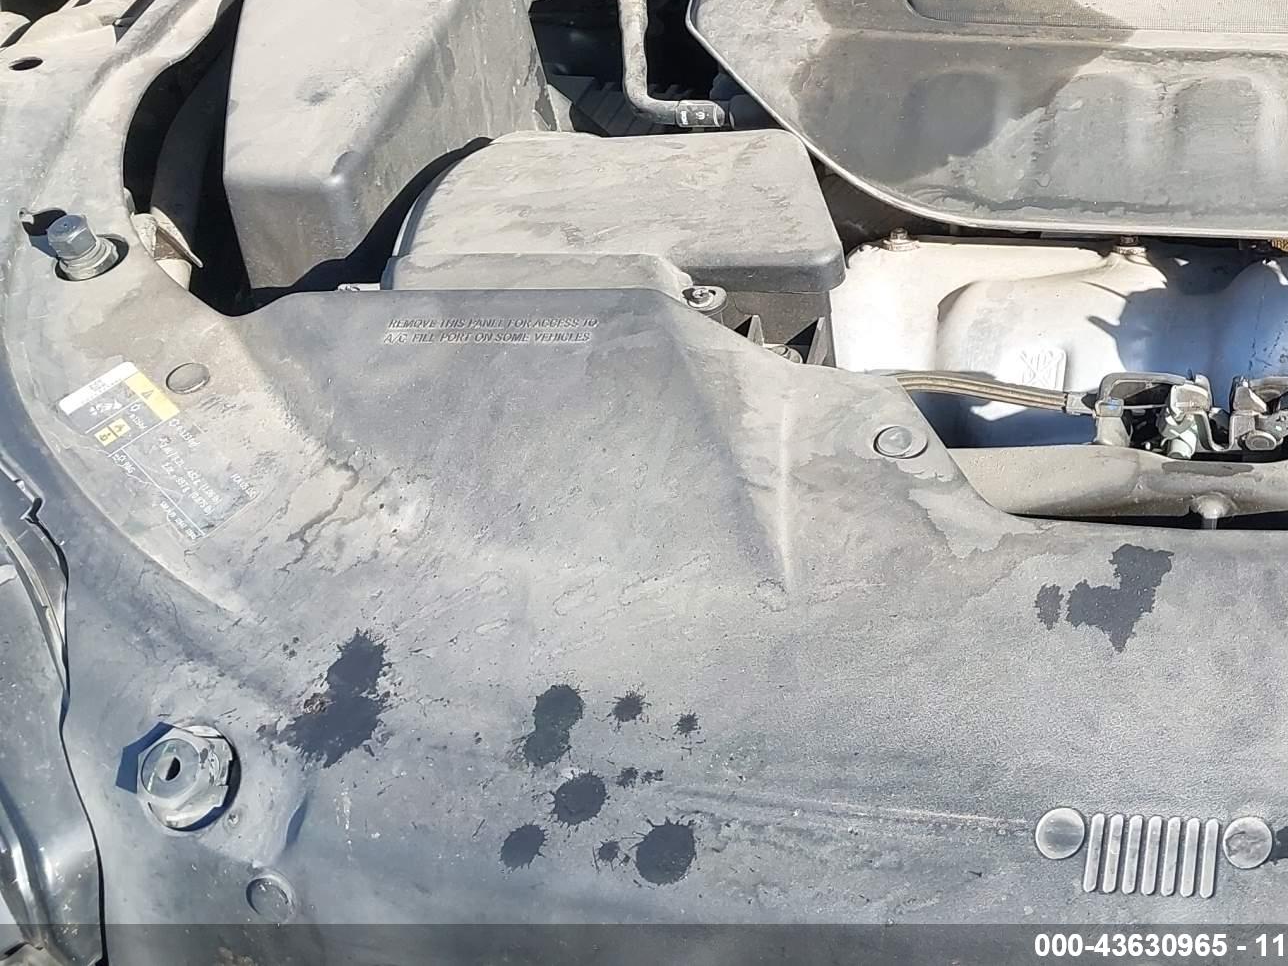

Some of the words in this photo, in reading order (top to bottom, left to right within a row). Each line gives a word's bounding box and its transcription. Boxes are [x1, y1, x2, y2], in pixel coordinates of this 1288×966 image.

[388, 319, 436, 330] REMOVE
[440, 319, 466, 330] THIS
[467, 319, 505, 330] PANEL
[507, 319, 532, 330] FOR
[532, 319, 580, 330] ACCESS
[582, 319, 599, 330] TO
[384, 333, 408, 344] A/C
[411, 333, 435, 344] FILL
[439, 333, 473, 344] PORT
[474, 333, 494, 344] ON
[494, 333, 529, 344] SOME
[534, 333, 592, 344] VEHICLES
